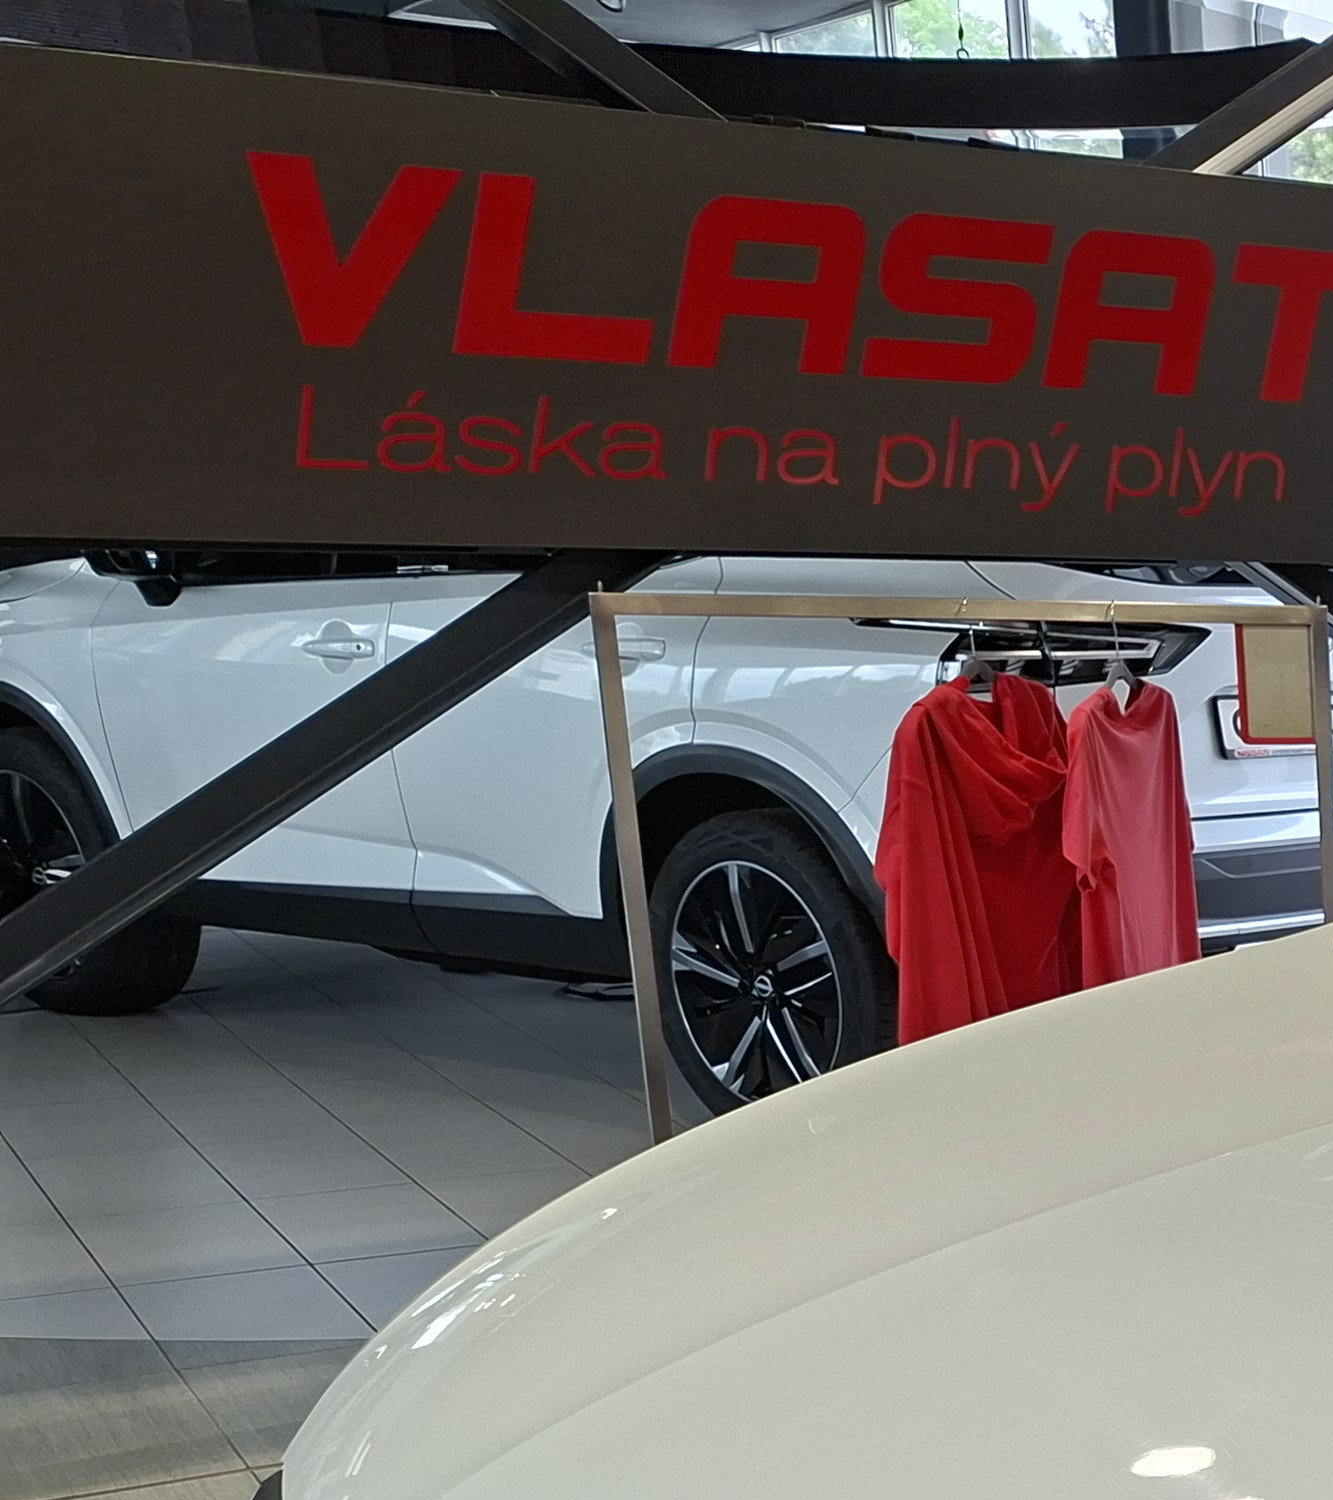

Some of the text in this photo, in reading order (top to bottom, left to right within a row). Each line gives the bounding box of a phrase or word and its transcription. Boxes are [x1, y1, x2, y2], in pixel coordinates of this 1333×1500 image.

[296, 384, 1287, 517] Láska na plný plyn
